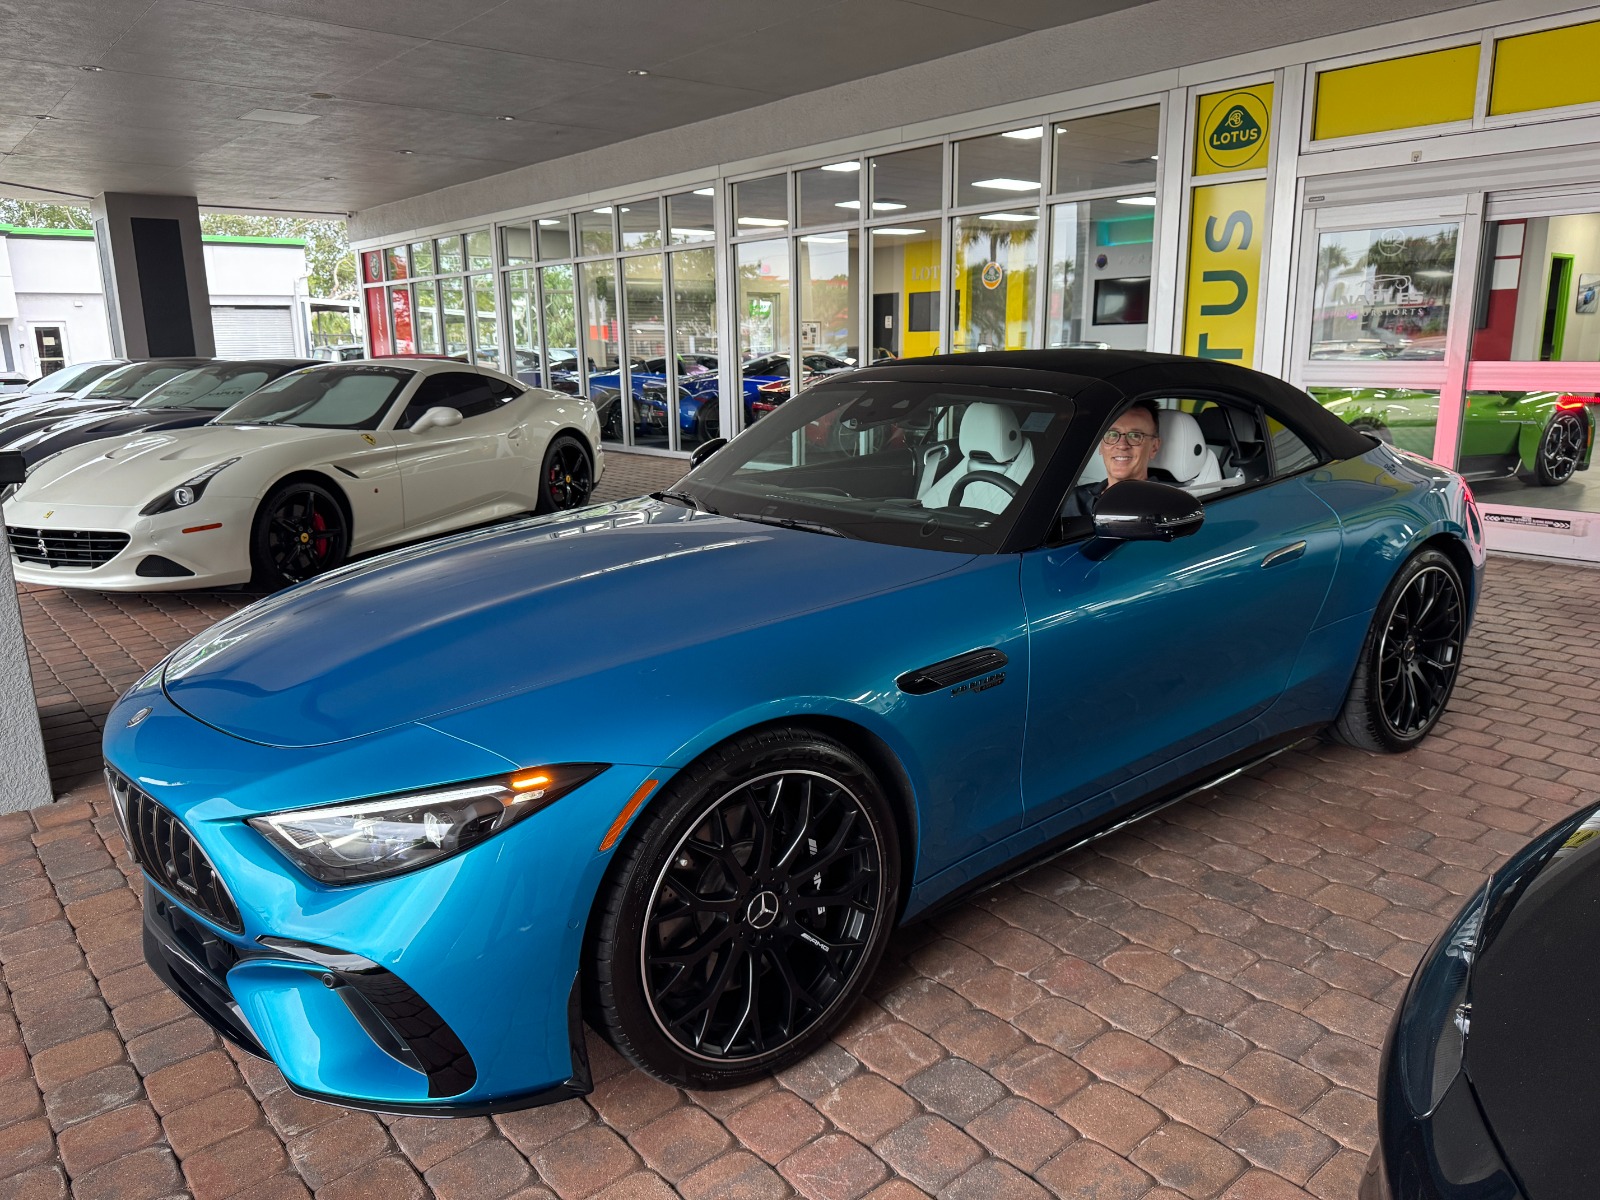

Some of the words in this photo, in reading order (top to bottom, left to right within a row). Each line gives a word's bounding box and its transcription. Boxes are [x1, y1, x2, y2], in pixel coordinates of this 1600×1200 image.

[1212, 128, 1259, 146] LOTUS
[911, 264, 960, 281] LOTS
[1197, 209, 1254, 360] TUS
[1338, 292, 1424, 306] NAPLES
[1346, 308, 1424, 318] ORSPORTS
